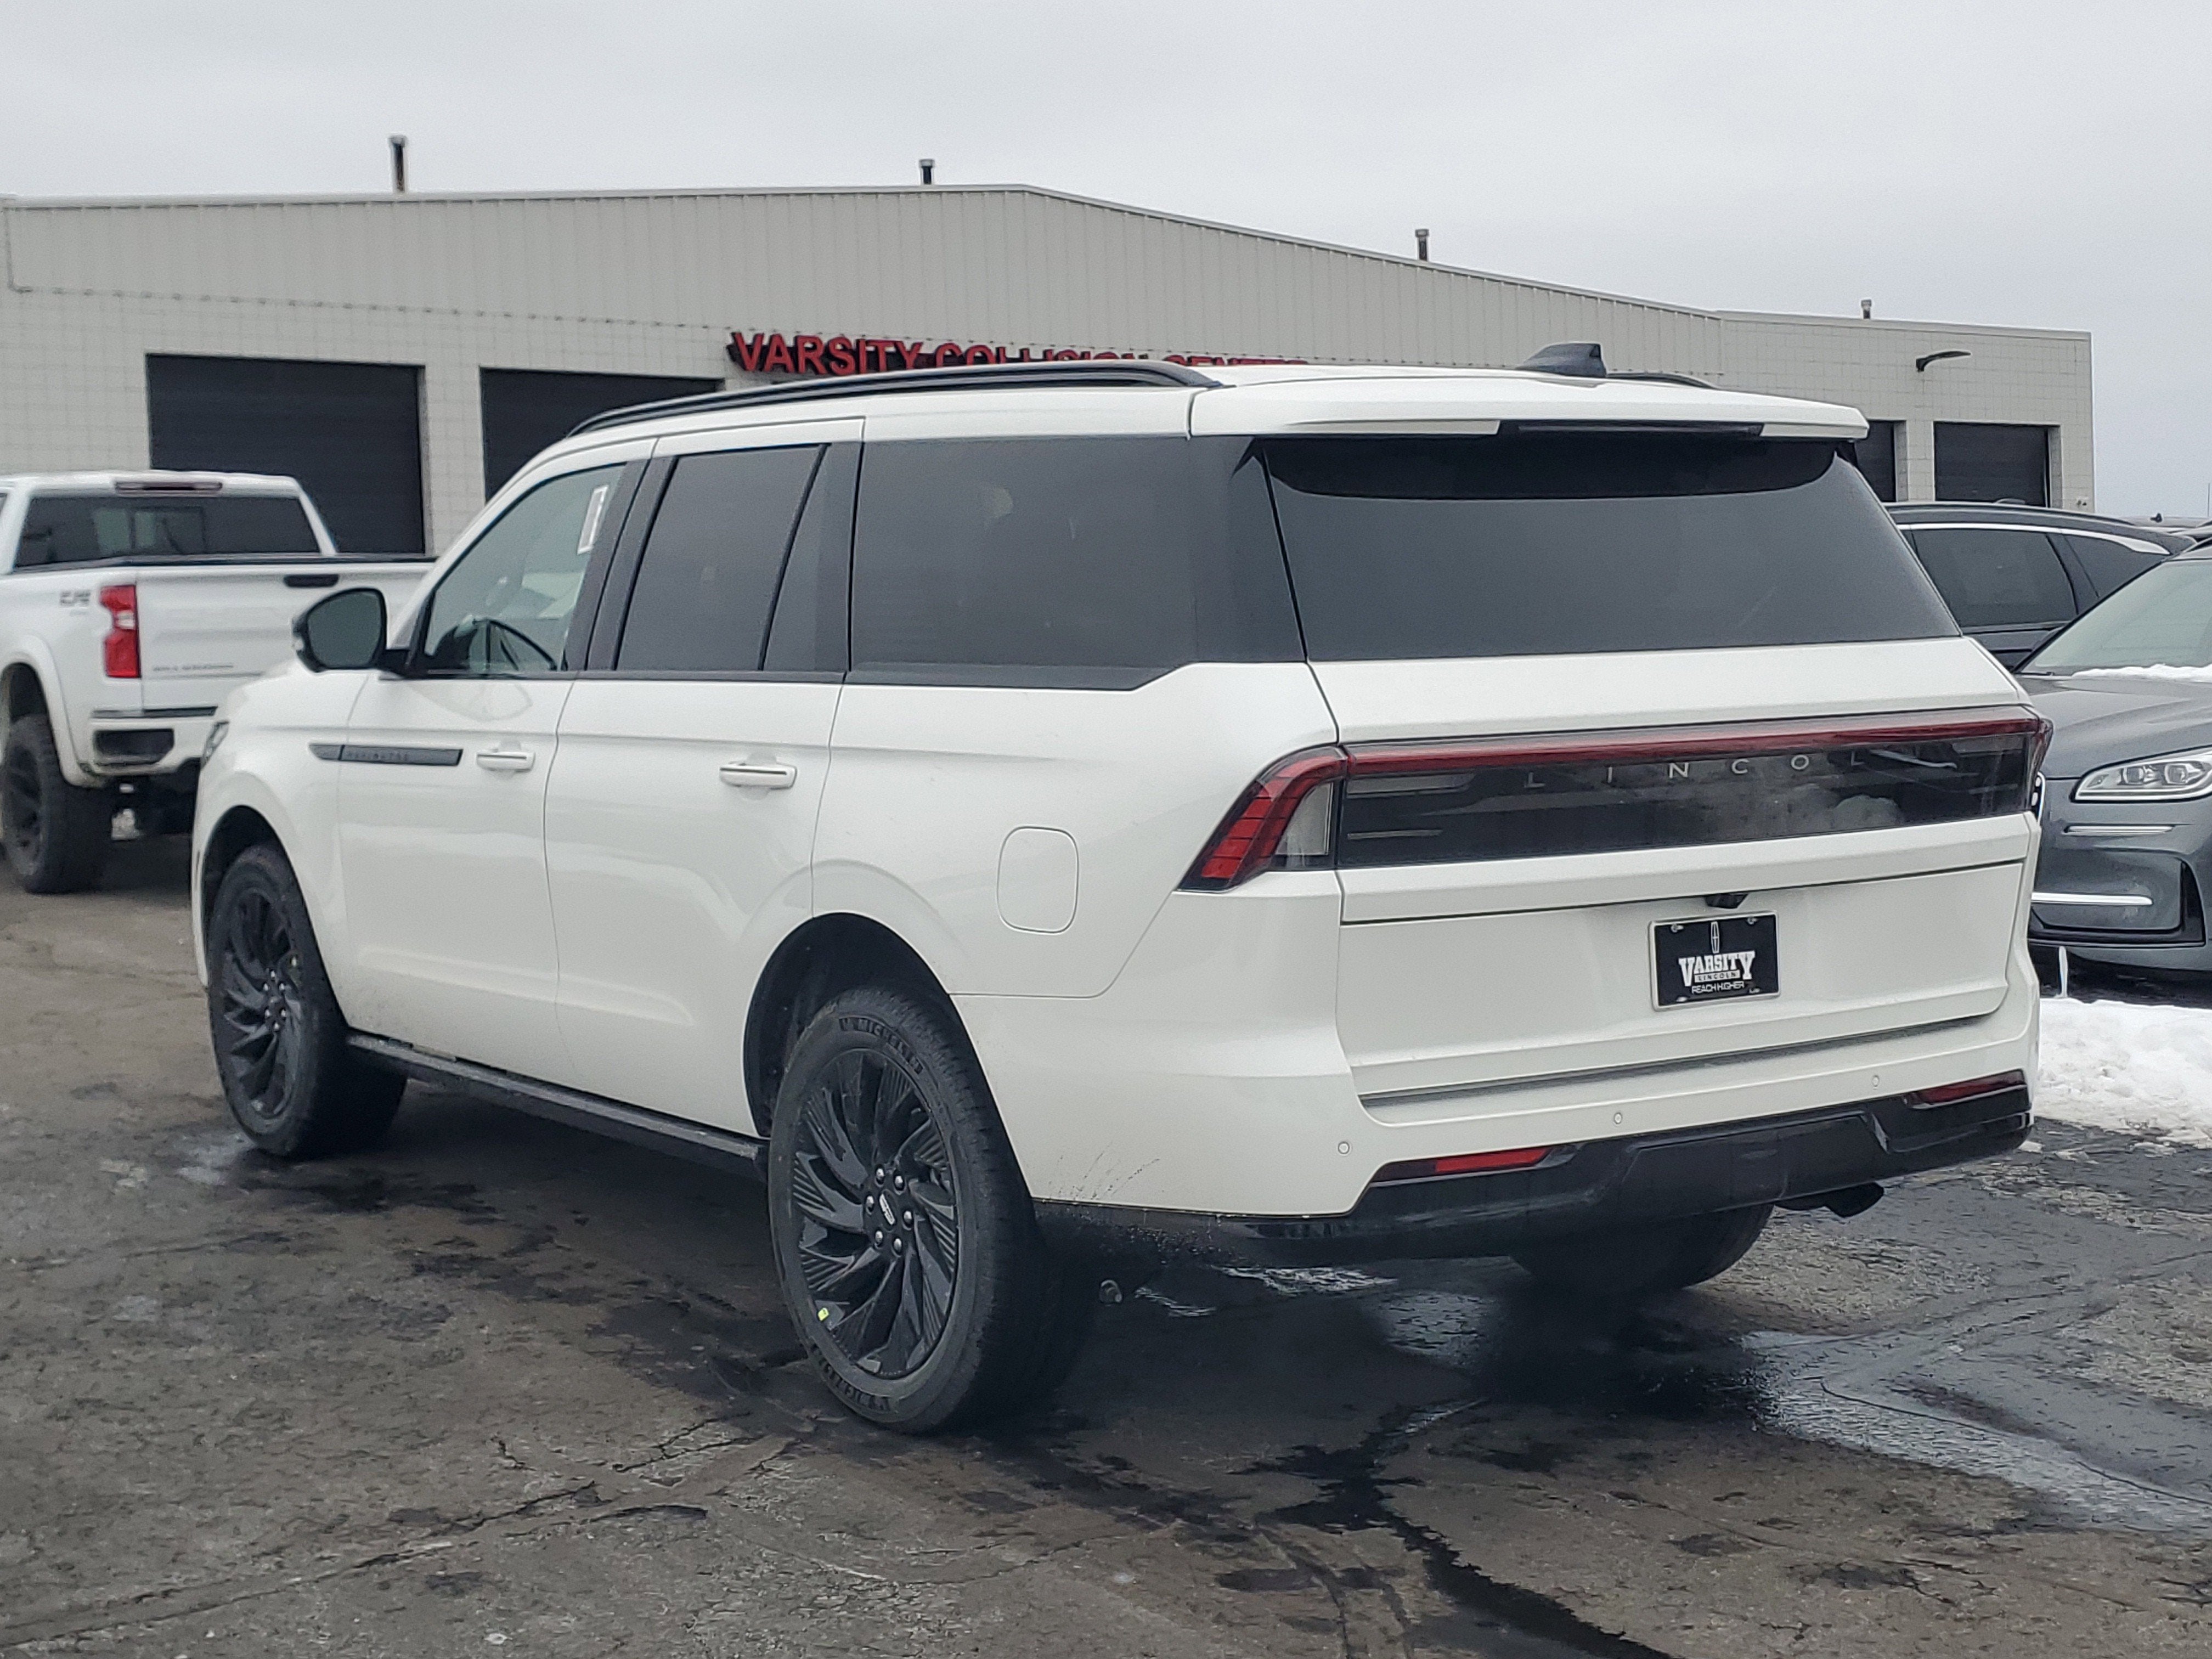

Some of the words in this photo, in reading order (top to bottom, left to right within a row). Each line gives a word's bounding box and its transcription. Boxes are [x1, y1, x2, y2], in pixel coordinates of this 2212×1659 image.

[732, 332, 923, 375] VARSITY
[1524, 746, 1893, 788] LINCOL
[1679, 951, 1755, 986] VARSITY
[1697, 972, 1737, 981] LINCOLN
[1691, 984, 1717, 994] REACH
[1717, 980, 1745, 991] HIGHER
